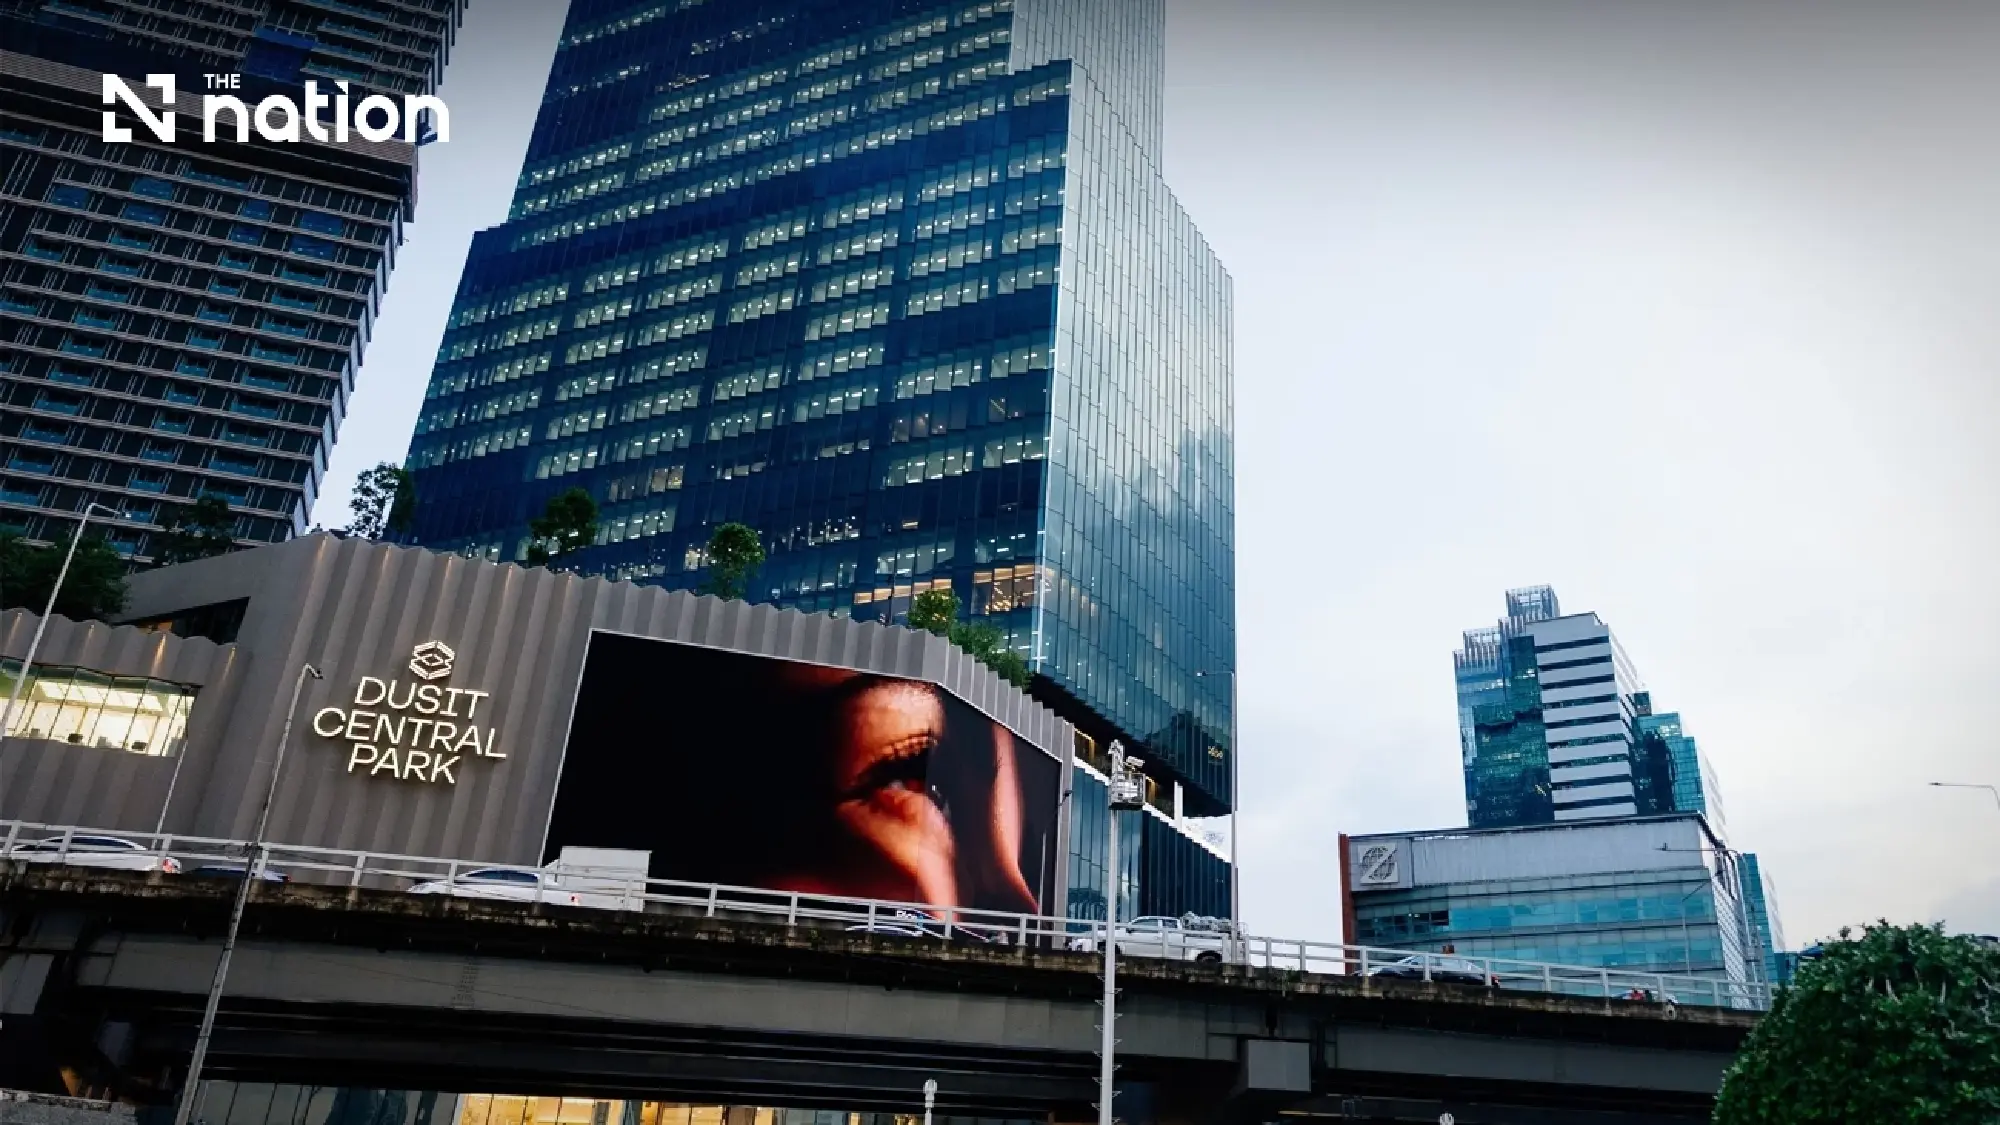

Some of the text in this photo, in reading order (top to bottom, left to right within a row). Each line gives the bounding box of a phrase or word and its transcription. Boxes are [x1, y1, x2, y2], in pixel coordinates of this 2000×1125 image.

[354, 676, 489, 719] DUSIT
[313, 707, 507, 758] CENTRAL
[347, 743, 461, 784] PARK
